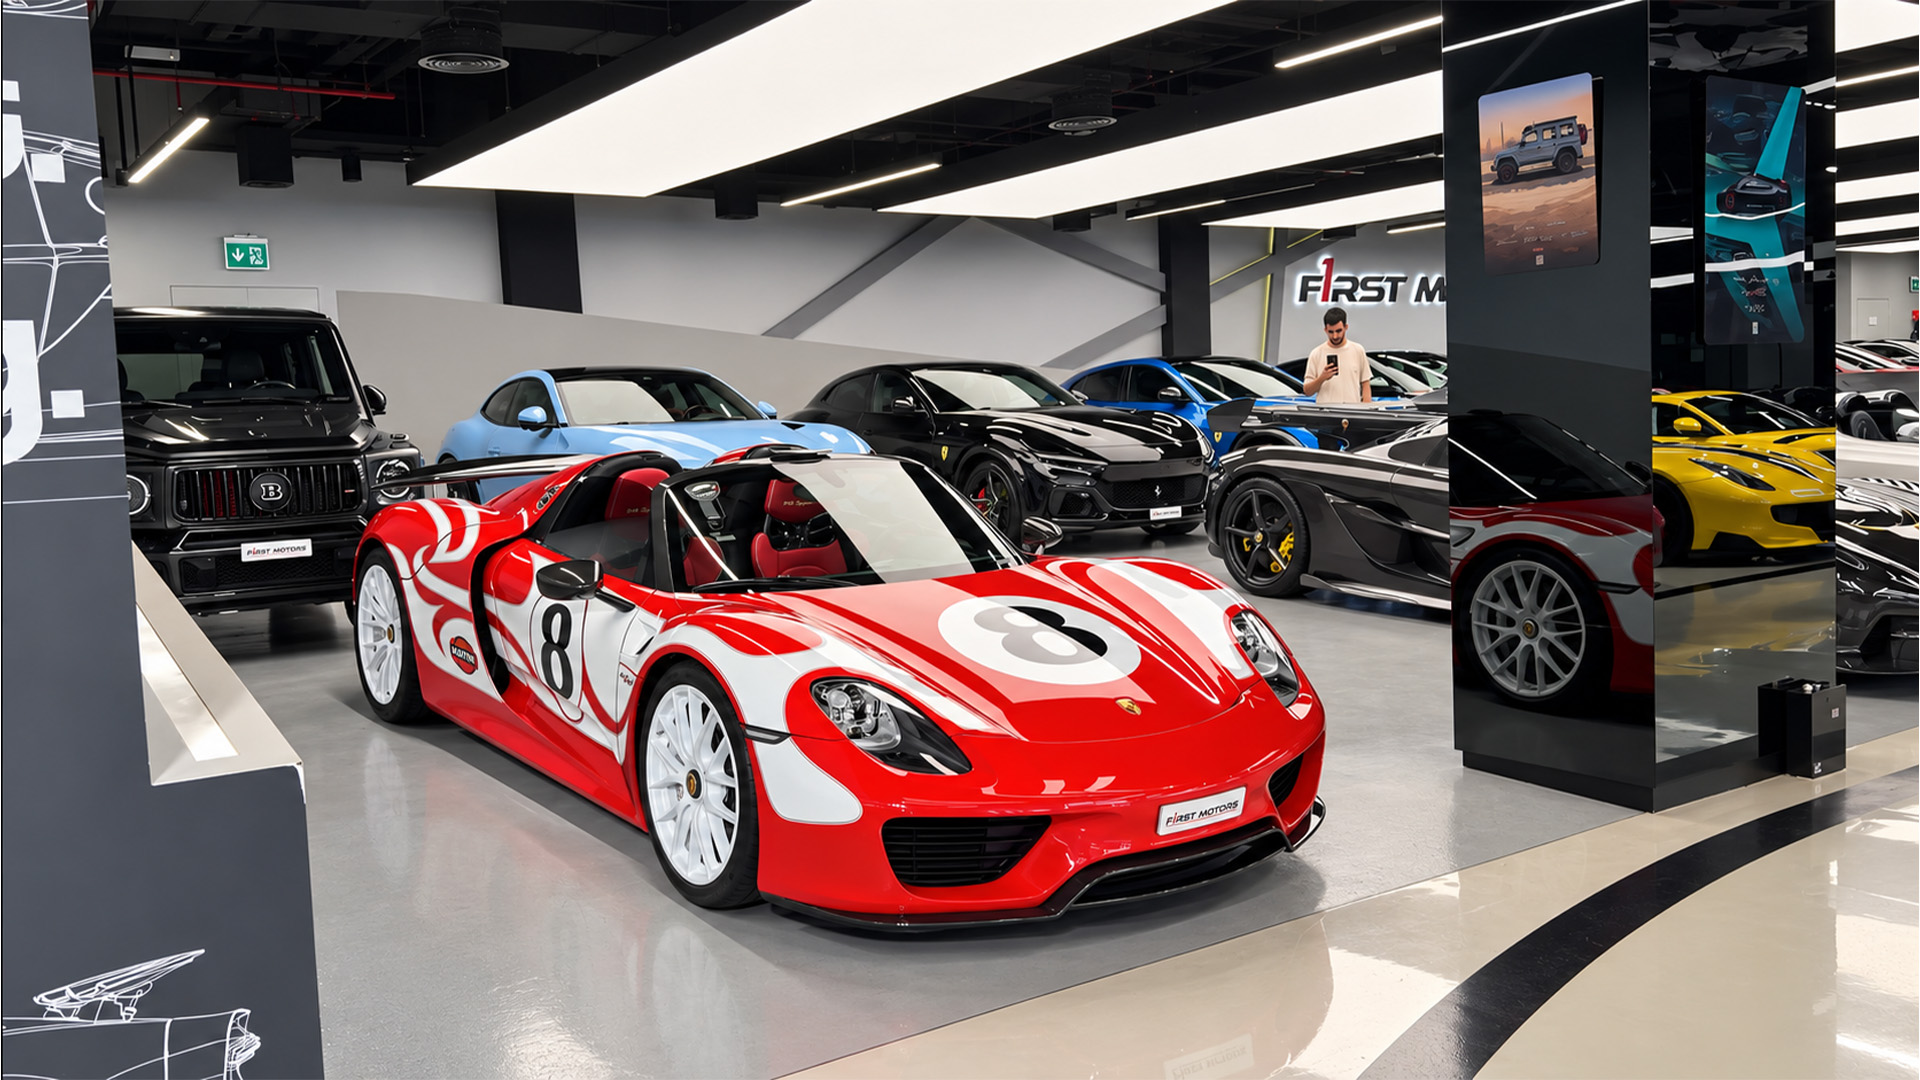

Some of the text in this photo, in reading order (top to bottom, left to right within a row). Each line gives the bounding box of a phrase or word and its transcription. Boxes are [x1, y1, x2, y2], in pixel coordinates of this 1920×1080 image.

[540, 602, 573, 700] 8
[973, 605, 1109, 666] 8
[1198, 799, 1239, 818] MOTORS
